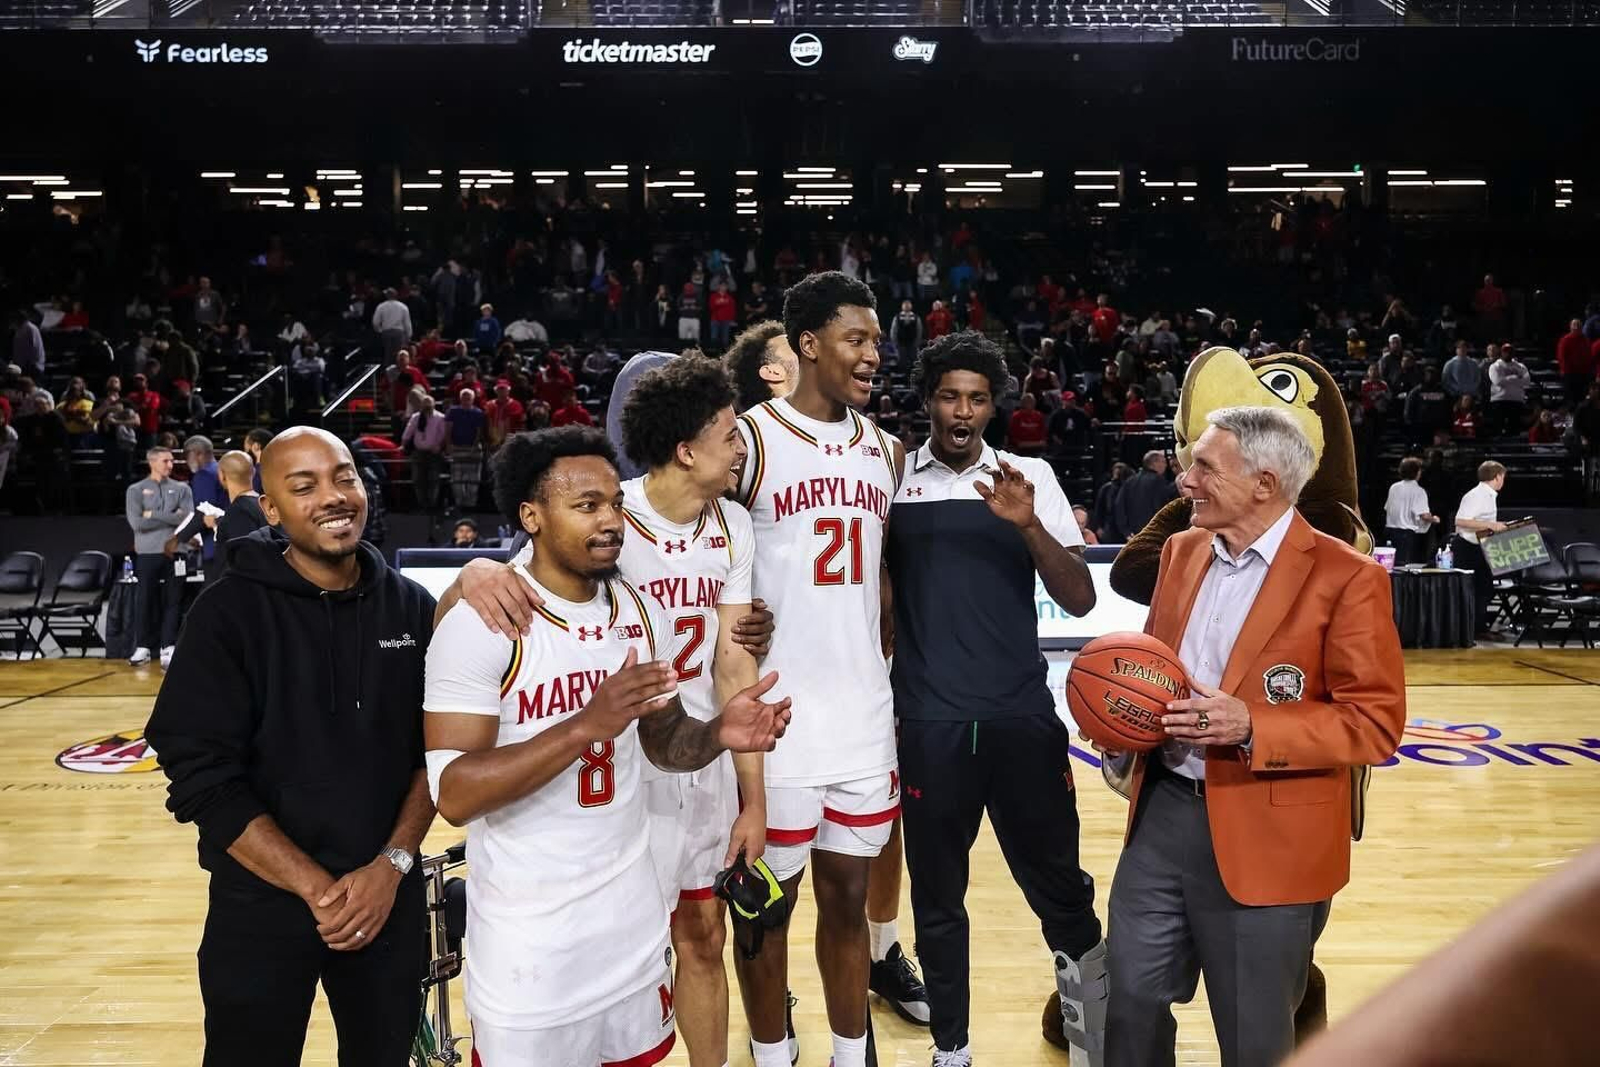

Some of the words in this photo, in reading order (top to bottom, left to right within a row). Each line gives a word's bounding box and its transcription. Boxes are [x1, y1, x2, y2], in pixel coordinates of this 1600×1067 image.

[167, 43, 268, 62] Fearless
[563, 38, 715, 62] ticketmaster
[893, 35, 937, 62] Starry
[1231, 37, 1360, 60] FutureCard
[773, 477, 888, 522] MARYLAND
[813, 517, 863, 586] 21
[638, 577, 725, 610] RYLAN
[672, 614, 705, 683] 2
[516, 669, 609, 725] MARY
[1103, 688, 1162, 726] LEGAC
[577, 737, 615, 808] 8
